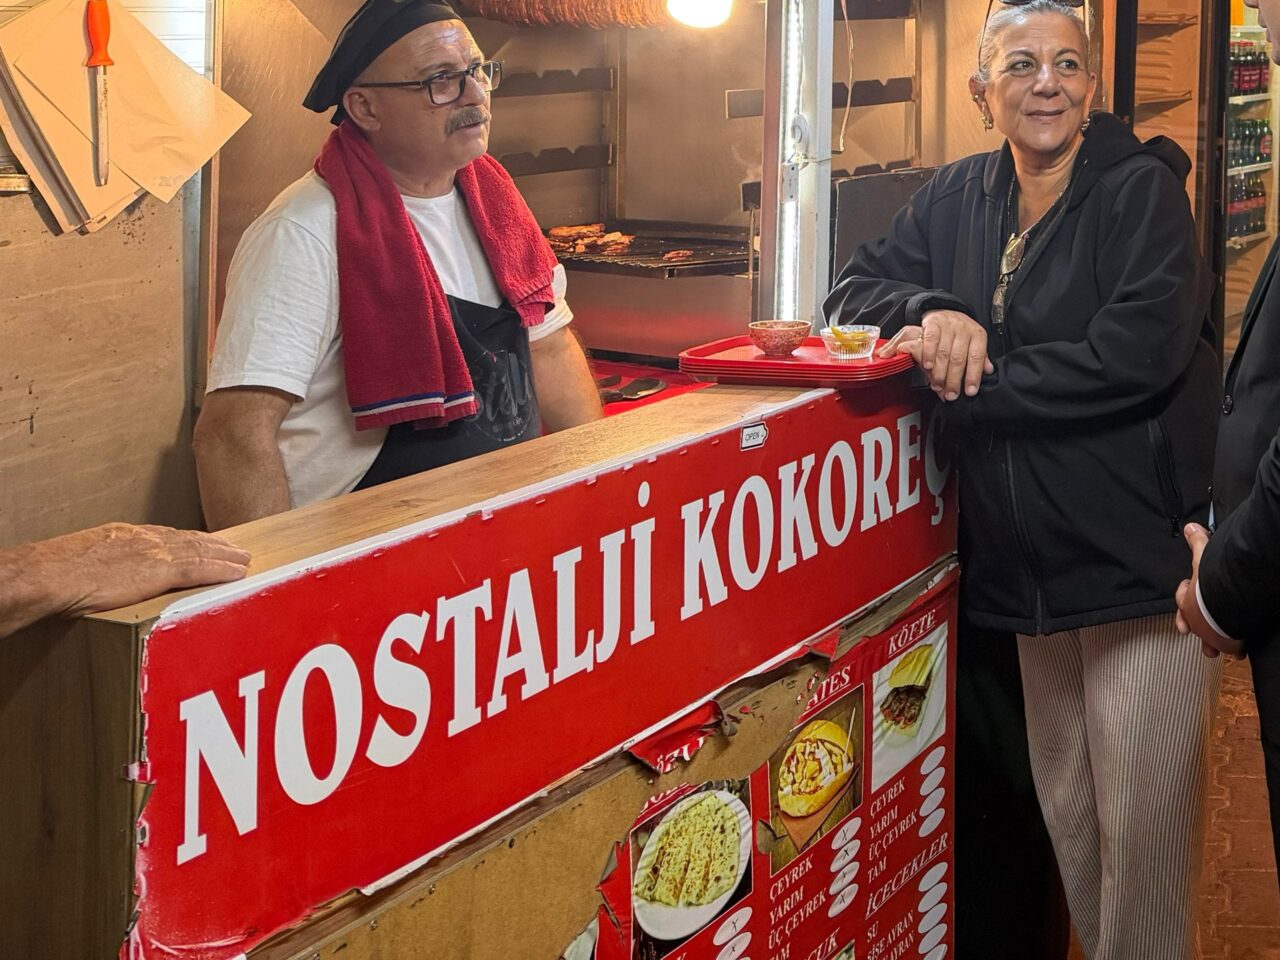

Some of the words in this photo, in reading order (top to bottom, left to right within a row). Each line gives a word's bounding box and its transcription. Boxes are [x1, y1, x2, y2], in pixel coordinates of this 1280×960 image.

[177, 480, 656, 866] NOSTALJİ
[681, 403, 952, 621] KOKOREÇ
[888, 609, 936, 656] KÖFTE
[870, 777, 906, 818] ÇEYREK
[868, 839, 882, 862] ÜÇ
[882, 809, 918, 849] ÇEYREK
[869, 805, 898, 839] YARIM
[770, 853, 814, 902] ÇEYREK
[865, 832, 949, 919] İÇECEKLER
[868, 856, 887, 884] TAM
[768, 927, 783, 950] ÜÇ
[785, 888, 827, 937] ÇEYREK
[769, 885, 804, 926] YARIM
[886, 909, 914, 947] AYRAN
